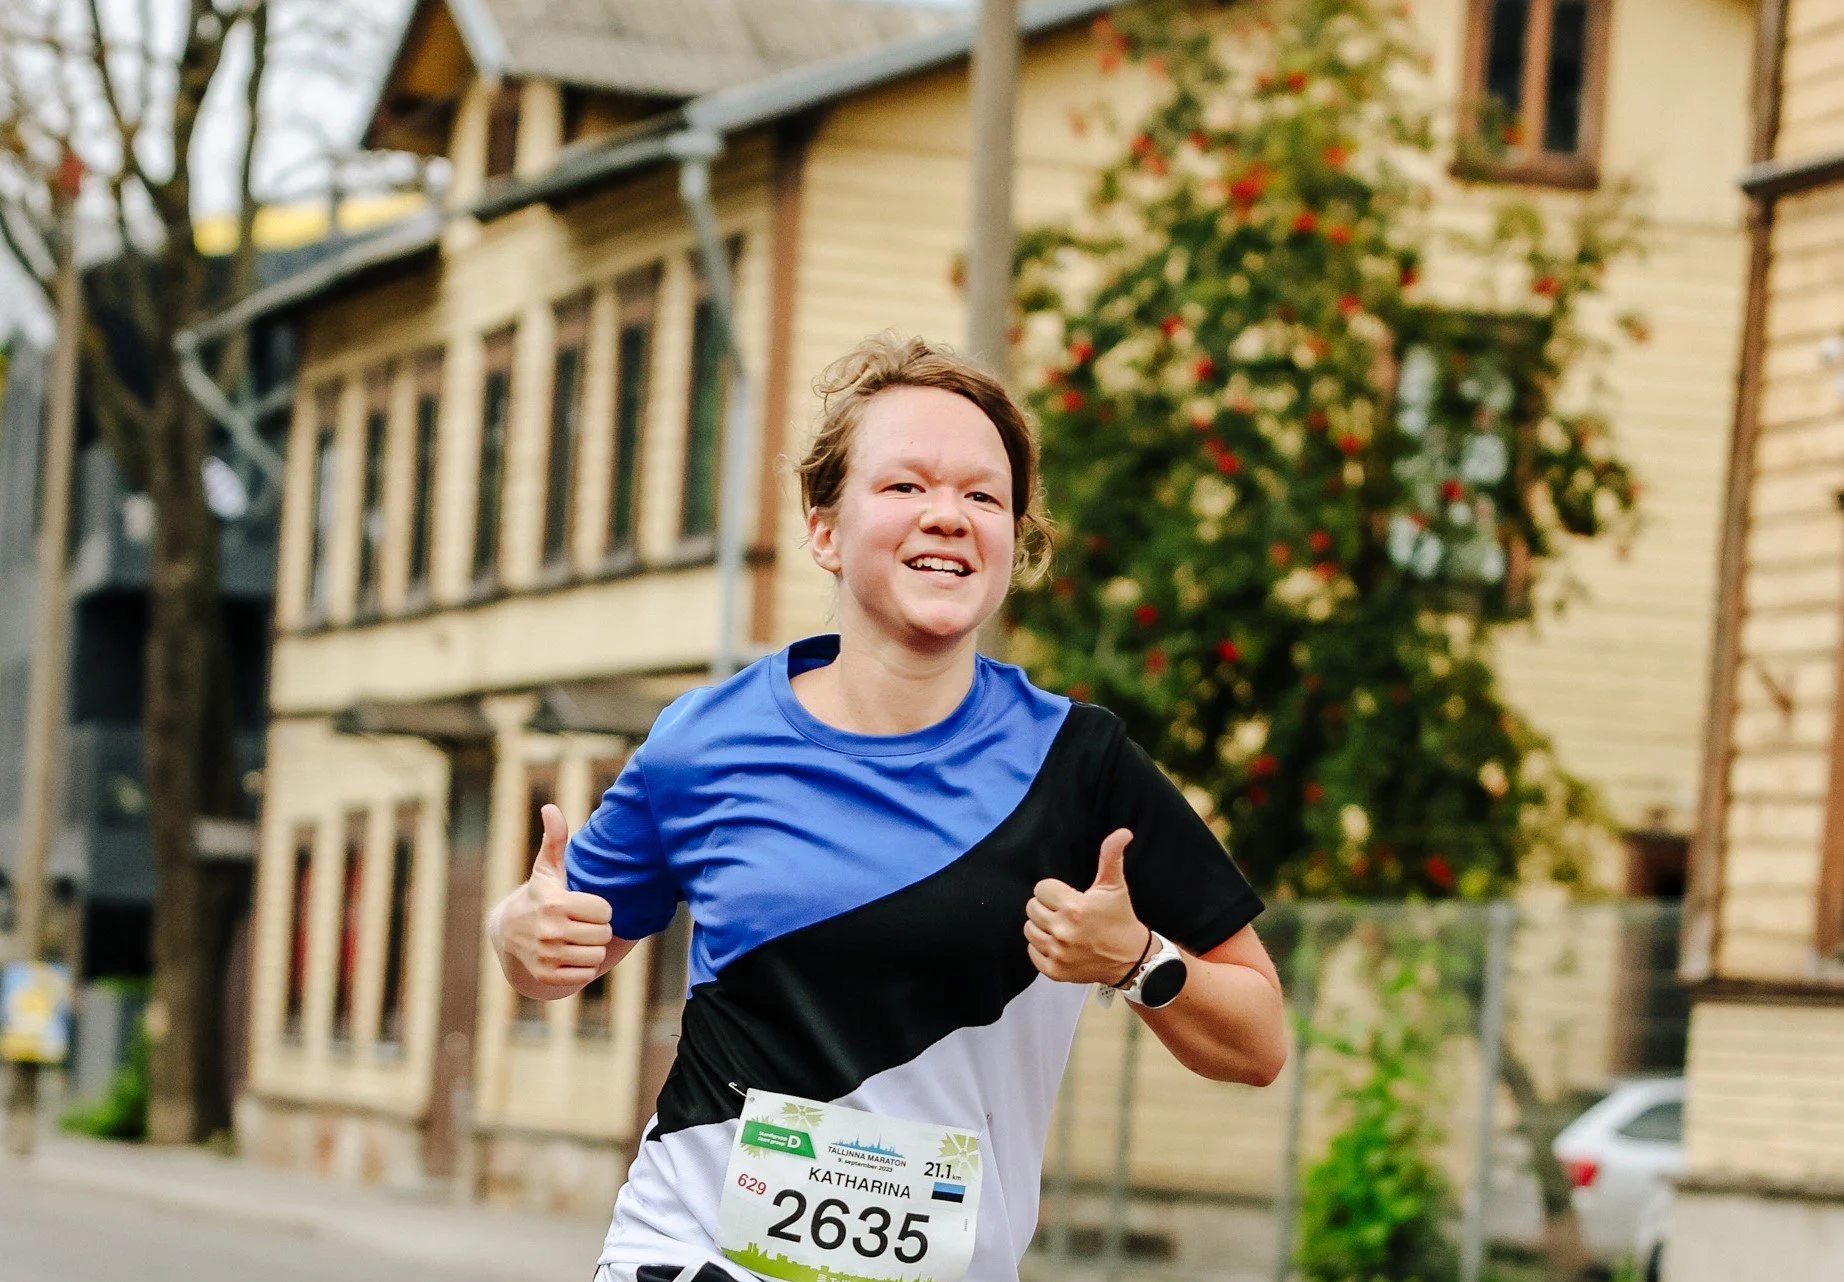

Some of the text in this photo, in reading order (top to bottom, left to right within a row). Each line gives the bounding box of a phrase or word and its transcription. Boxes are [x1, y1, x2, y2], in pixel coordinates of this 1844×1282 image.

[787, 1135, 801, 1148] D
[828, 1146, 907, 1168] TALLINNA MARATON
[924, 1161, 952, 1179] 21.1
[737, 1174, 767, 1196] 629
[808, 1167, 911, 1199] KATHARINA
[767, 1188, 930, 1264] 2635
